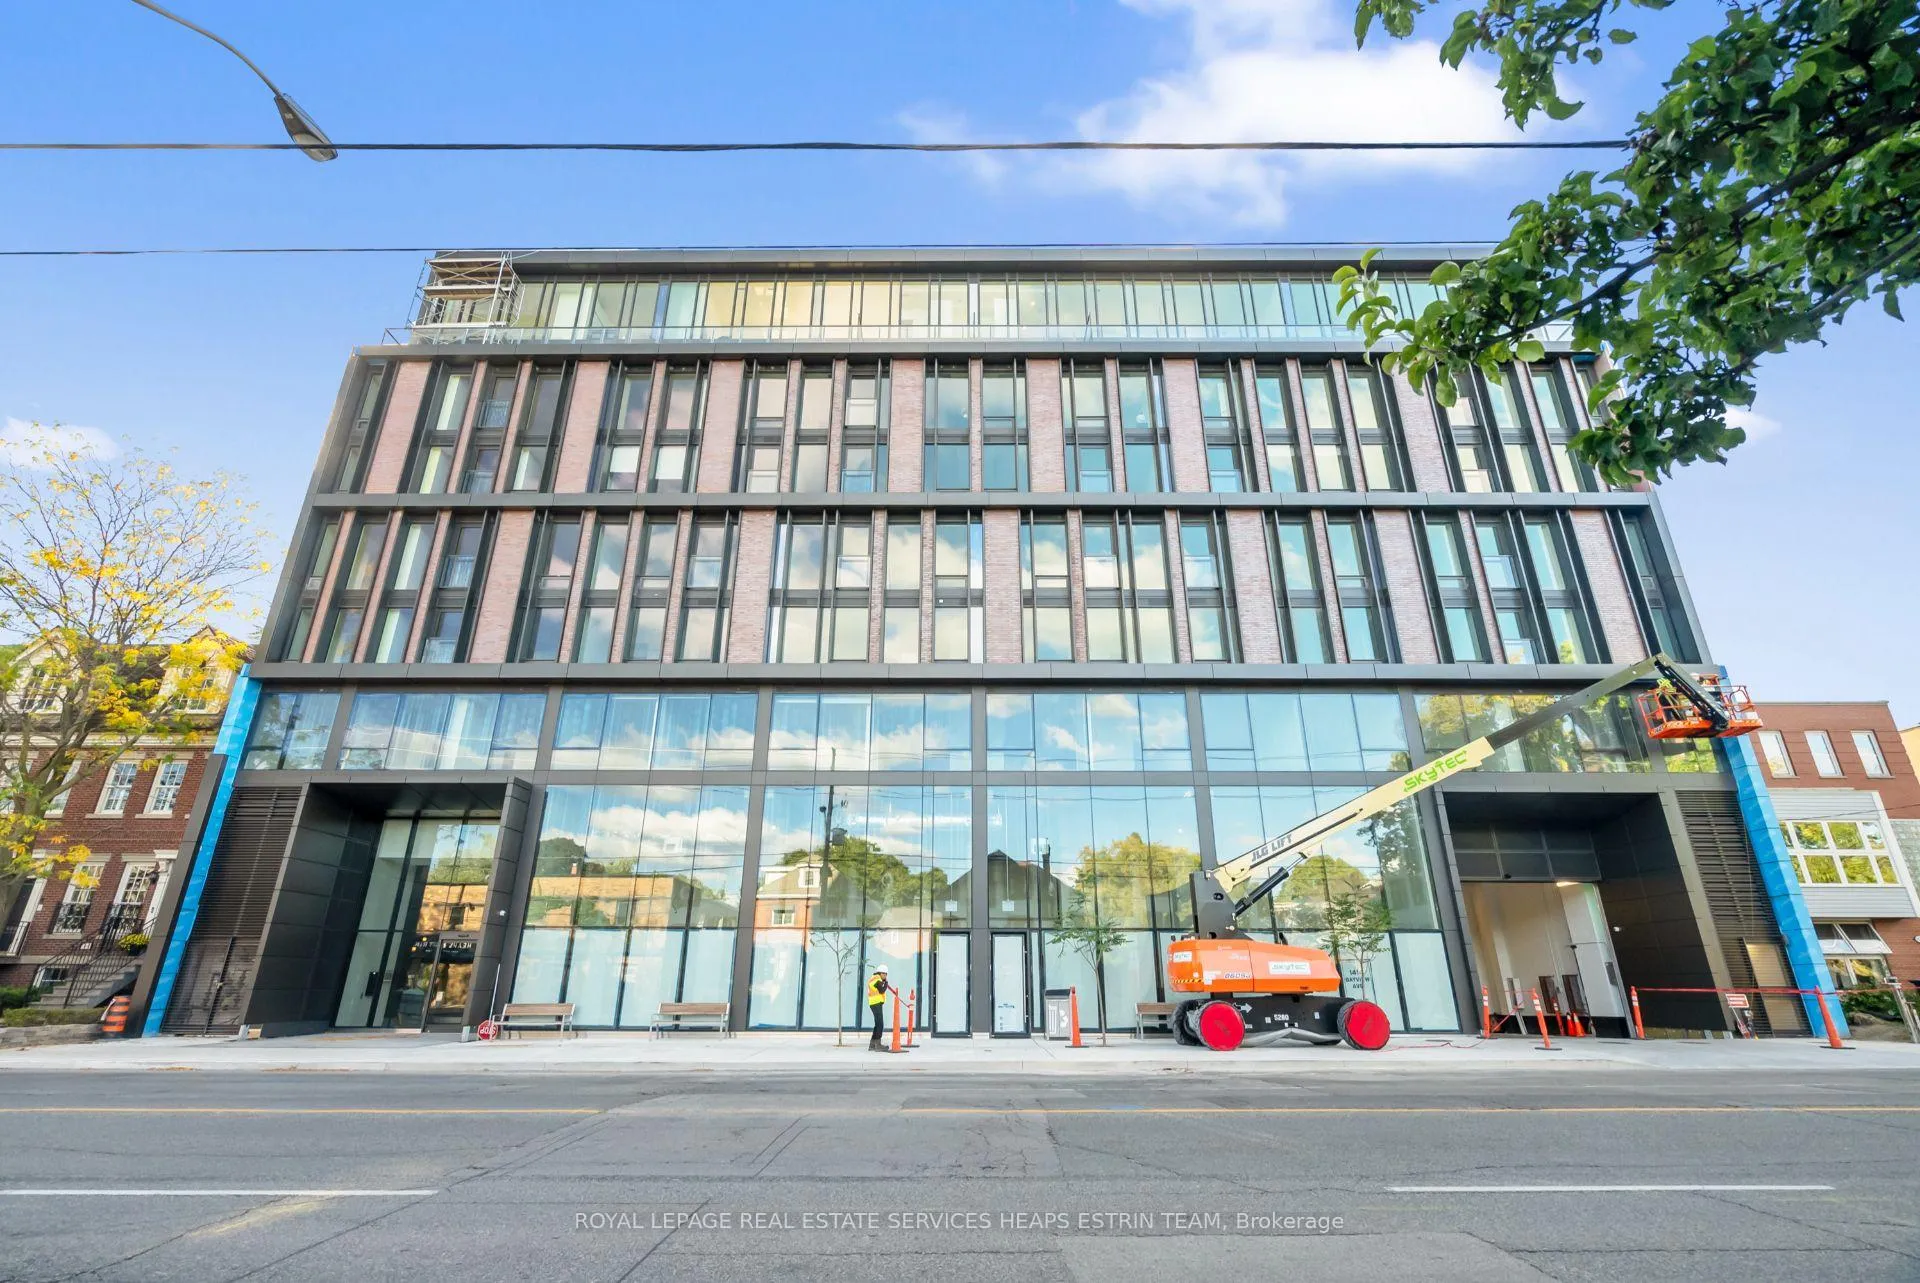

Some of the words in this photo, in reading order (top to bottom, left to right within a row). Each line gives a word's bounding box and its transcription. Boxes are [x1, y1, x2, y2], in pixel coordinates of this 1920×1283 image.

[1403, 750, 1467, 791] SKYTEC
[1252, 845, 1269, 862] JLG
[1271, 834, 1292, 851] LIFT
